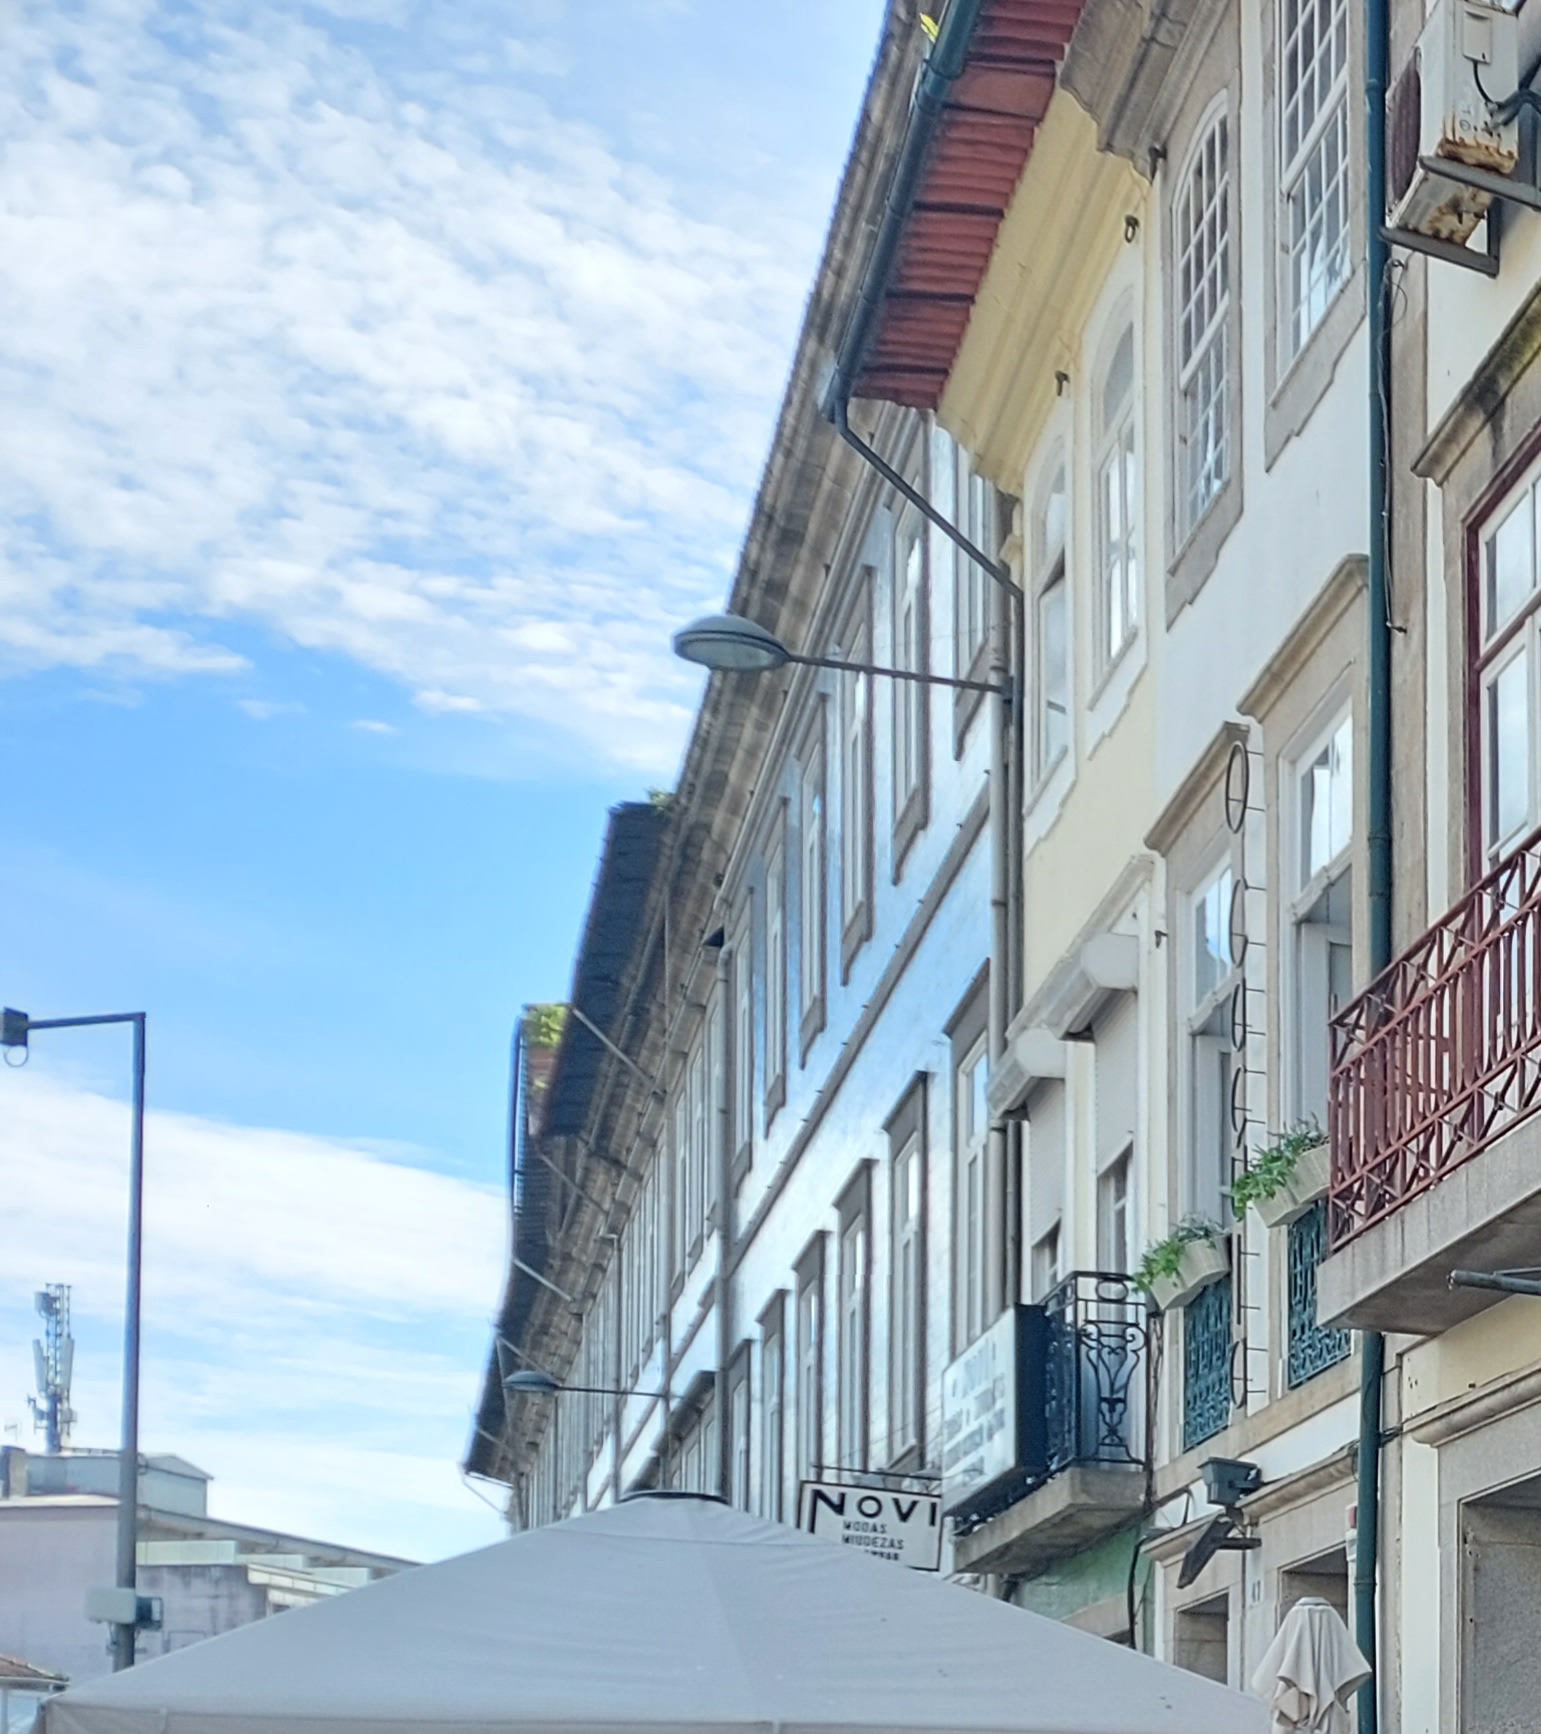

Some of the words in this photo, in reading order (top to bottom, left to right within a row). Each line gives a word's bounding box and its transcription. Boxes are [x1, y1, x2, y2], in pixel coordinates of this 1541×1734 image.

[808, 1489, 937, 1534] NOVI
[843, 1520, 887, 1534] MODAS
[842, 1534, 904, 1549] MIUDEZAS
